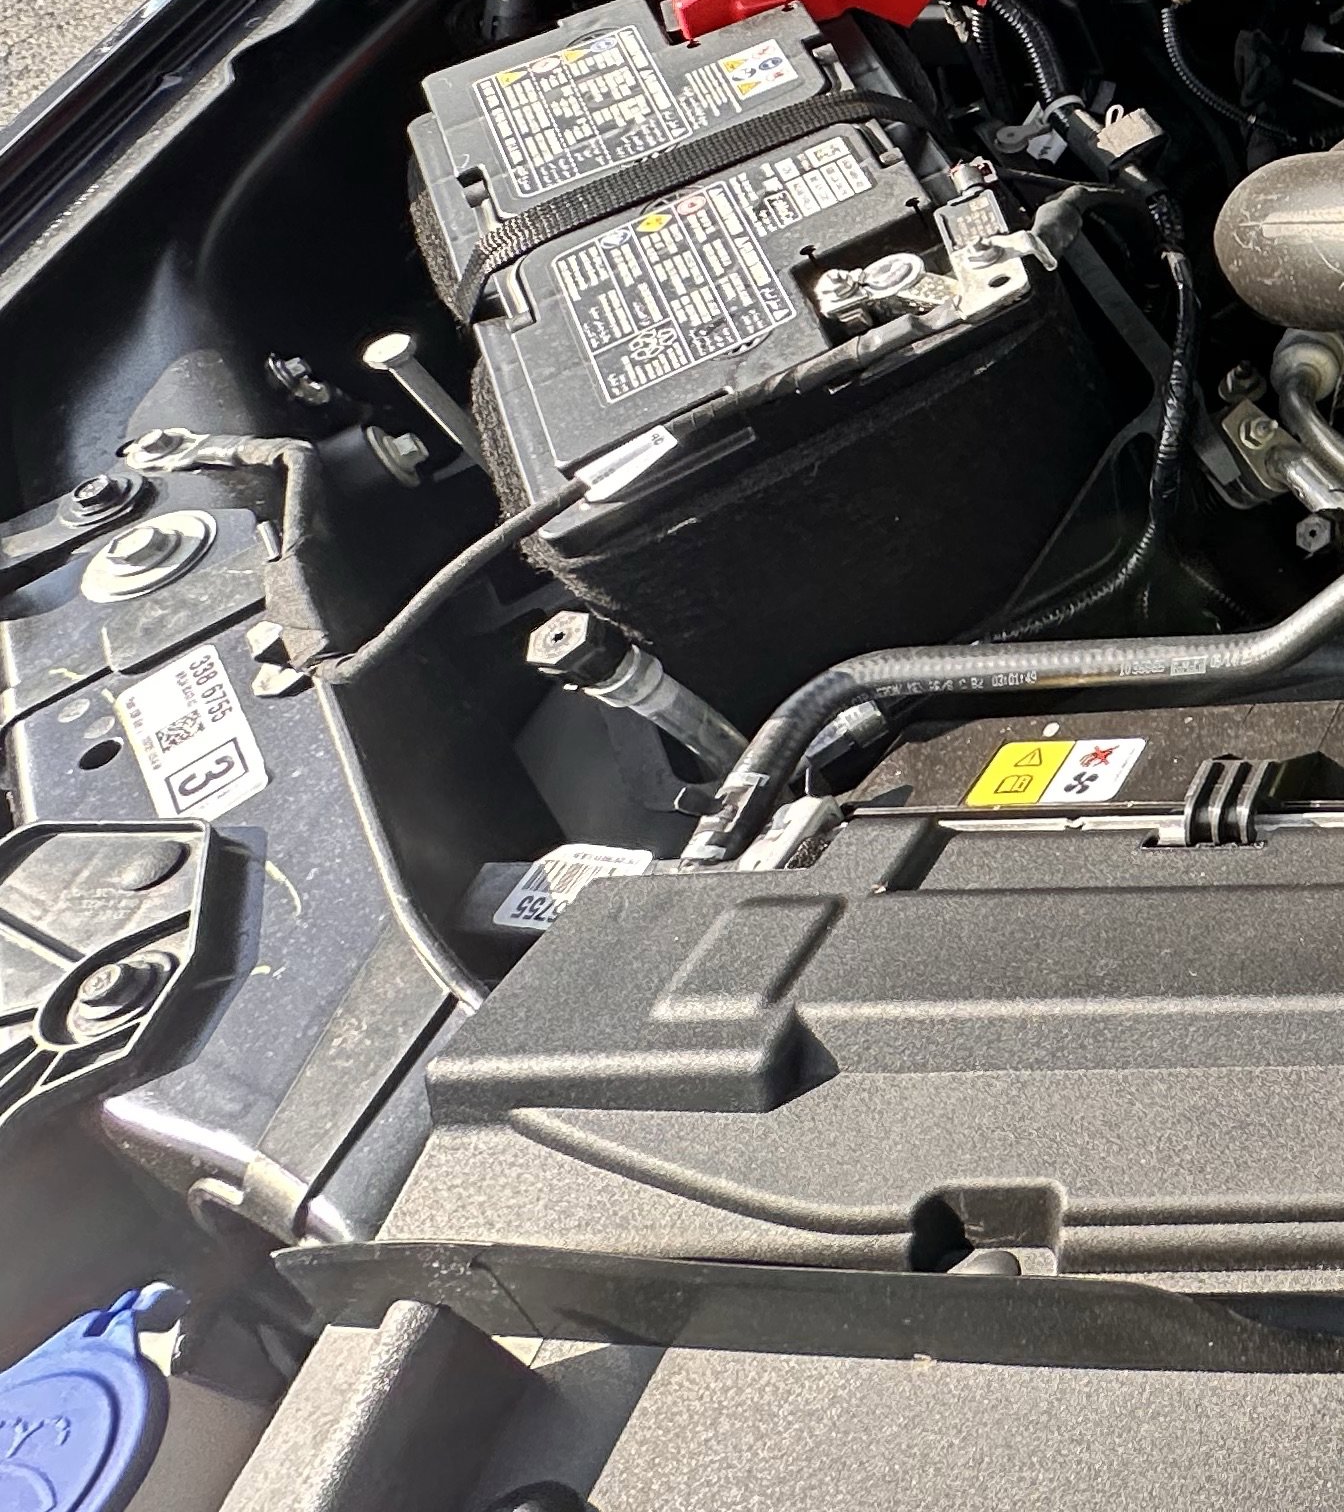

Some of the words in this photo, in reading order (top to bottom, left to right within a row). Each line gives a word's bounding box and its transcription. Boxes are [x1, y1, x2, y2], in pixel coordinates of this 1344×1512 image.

[189, 654, 219, 686] 338
[201, 683, 233, 723] 6755
[178, 755, 236, 797] 3
